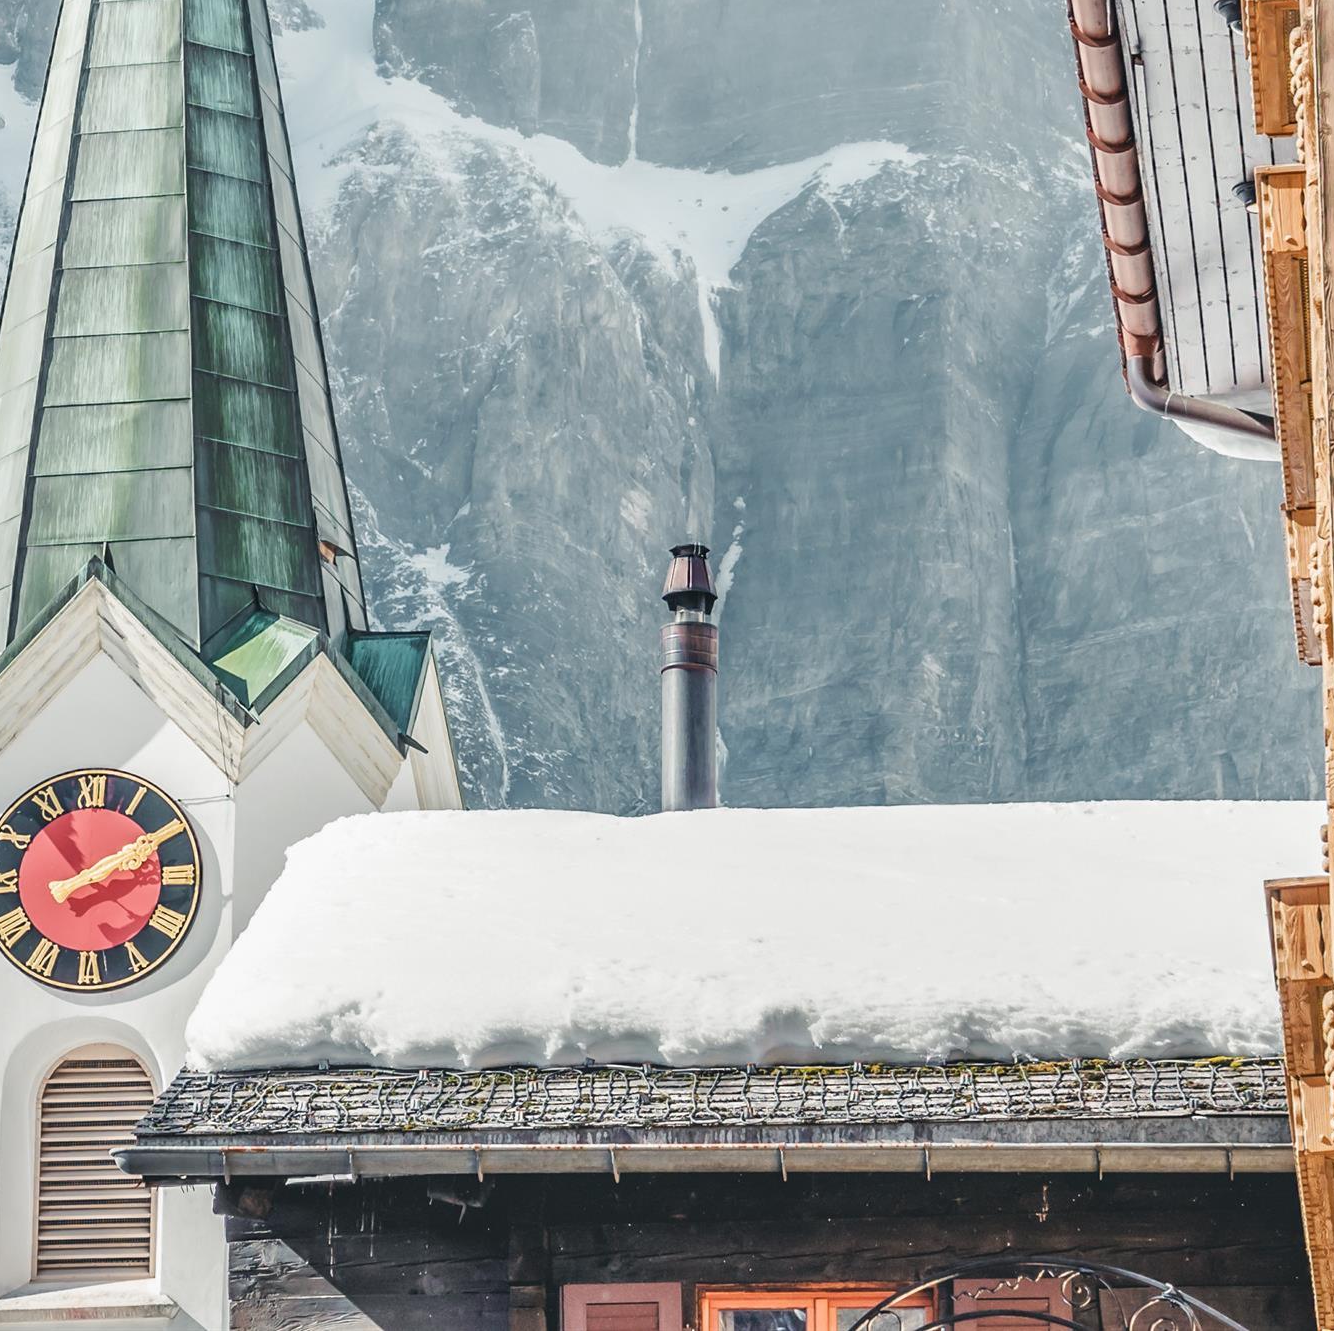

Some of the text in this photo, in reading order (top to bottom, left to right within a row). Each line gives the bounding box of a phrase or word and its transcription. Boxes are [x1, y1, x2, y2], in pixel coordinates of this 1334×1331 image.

[77, 774, 107, 808] XII
[125, 786, 148, 816] I
[161, 864, 195, 885] III
[148, 903, 187, 939] IIII
[77, 951, 102, 985] VI
[124, 941, 150, 973] V
